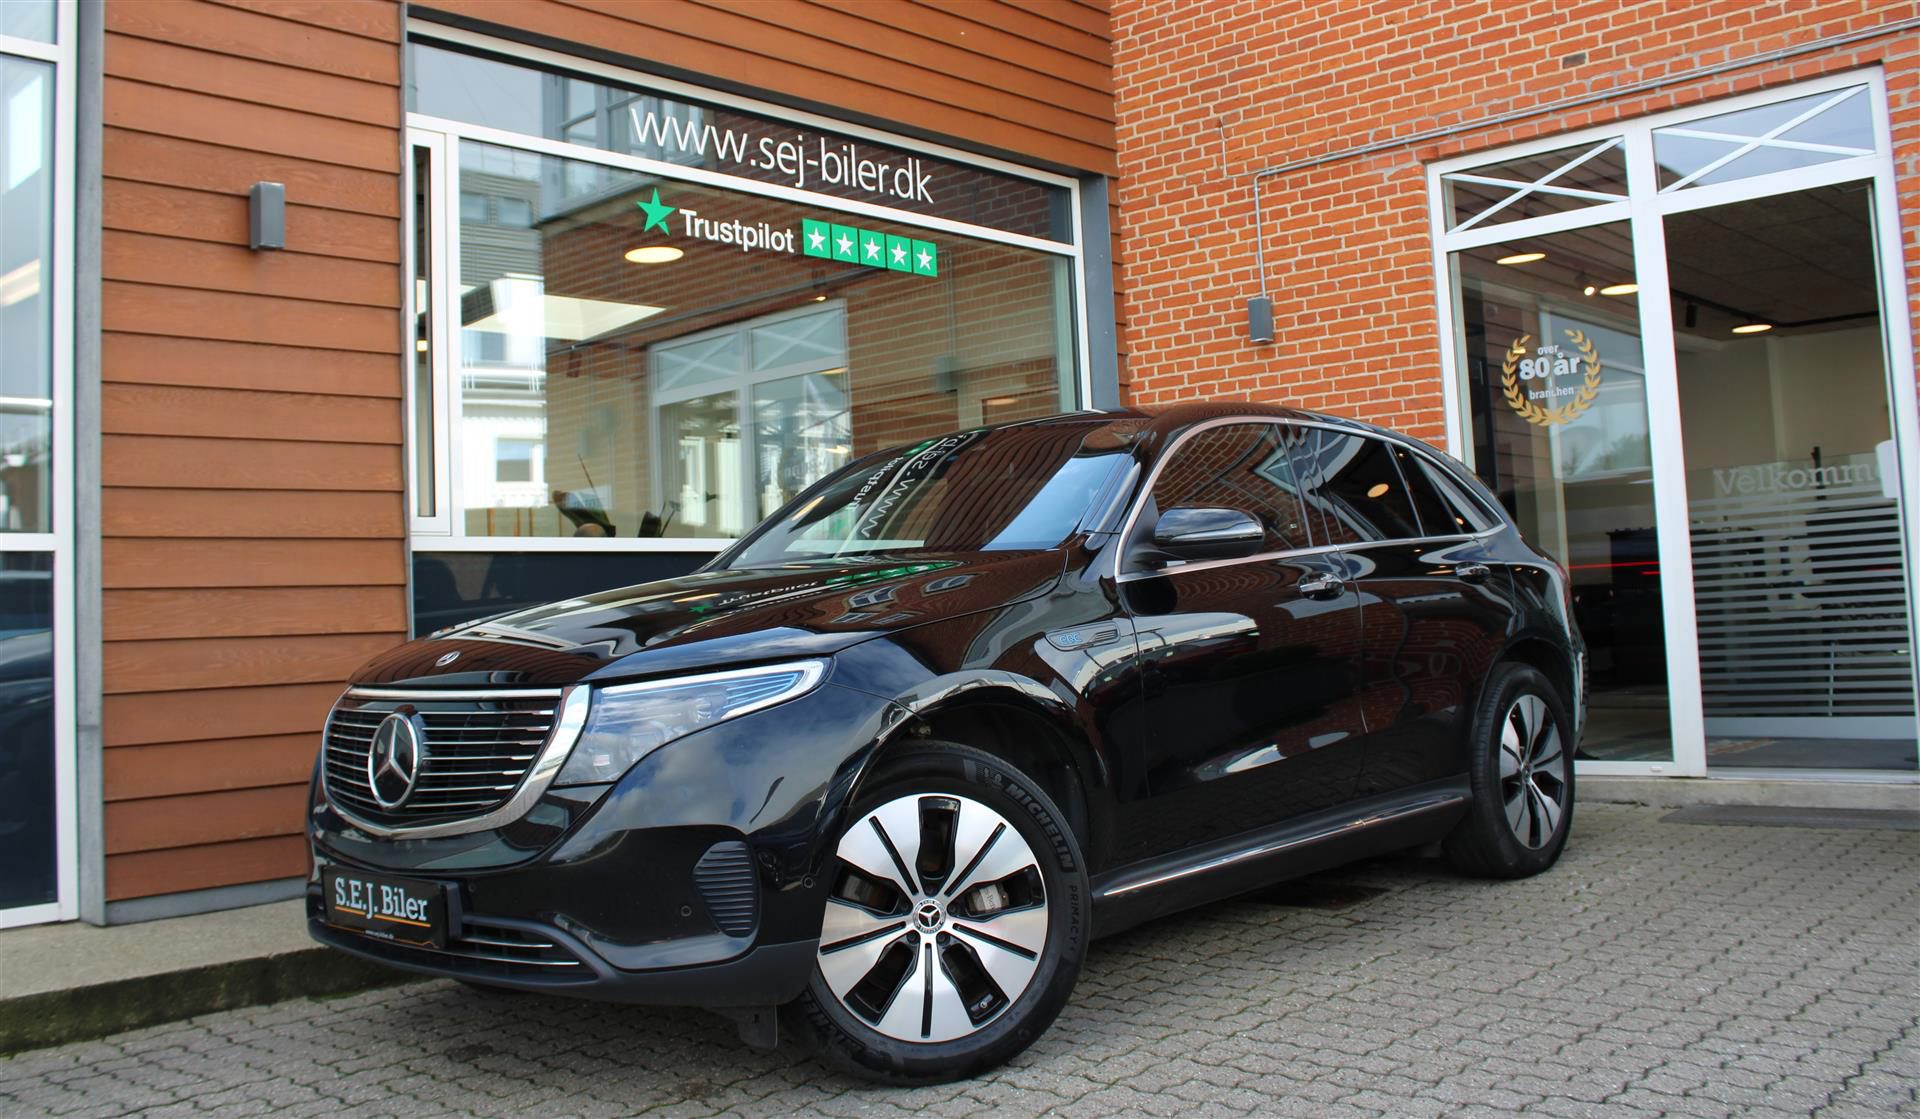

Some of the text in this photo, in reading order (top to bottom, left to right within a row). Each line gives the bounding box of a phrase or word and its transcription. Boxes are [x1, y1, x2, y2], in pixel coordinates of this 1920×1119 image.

[630, 108, 934, 203] www.sej-biler.dk
[679, 208, 796, 253] Trustpilot
[1519, 352, 1580, 380] 80 år
[1537, 345, 1559, 355] over
[1713, 463, 1880, 494] Velkomm
[1005, 784, 1074, 870] MICHELIN
[335, 877, 428, 921] S.E.J. Biler
